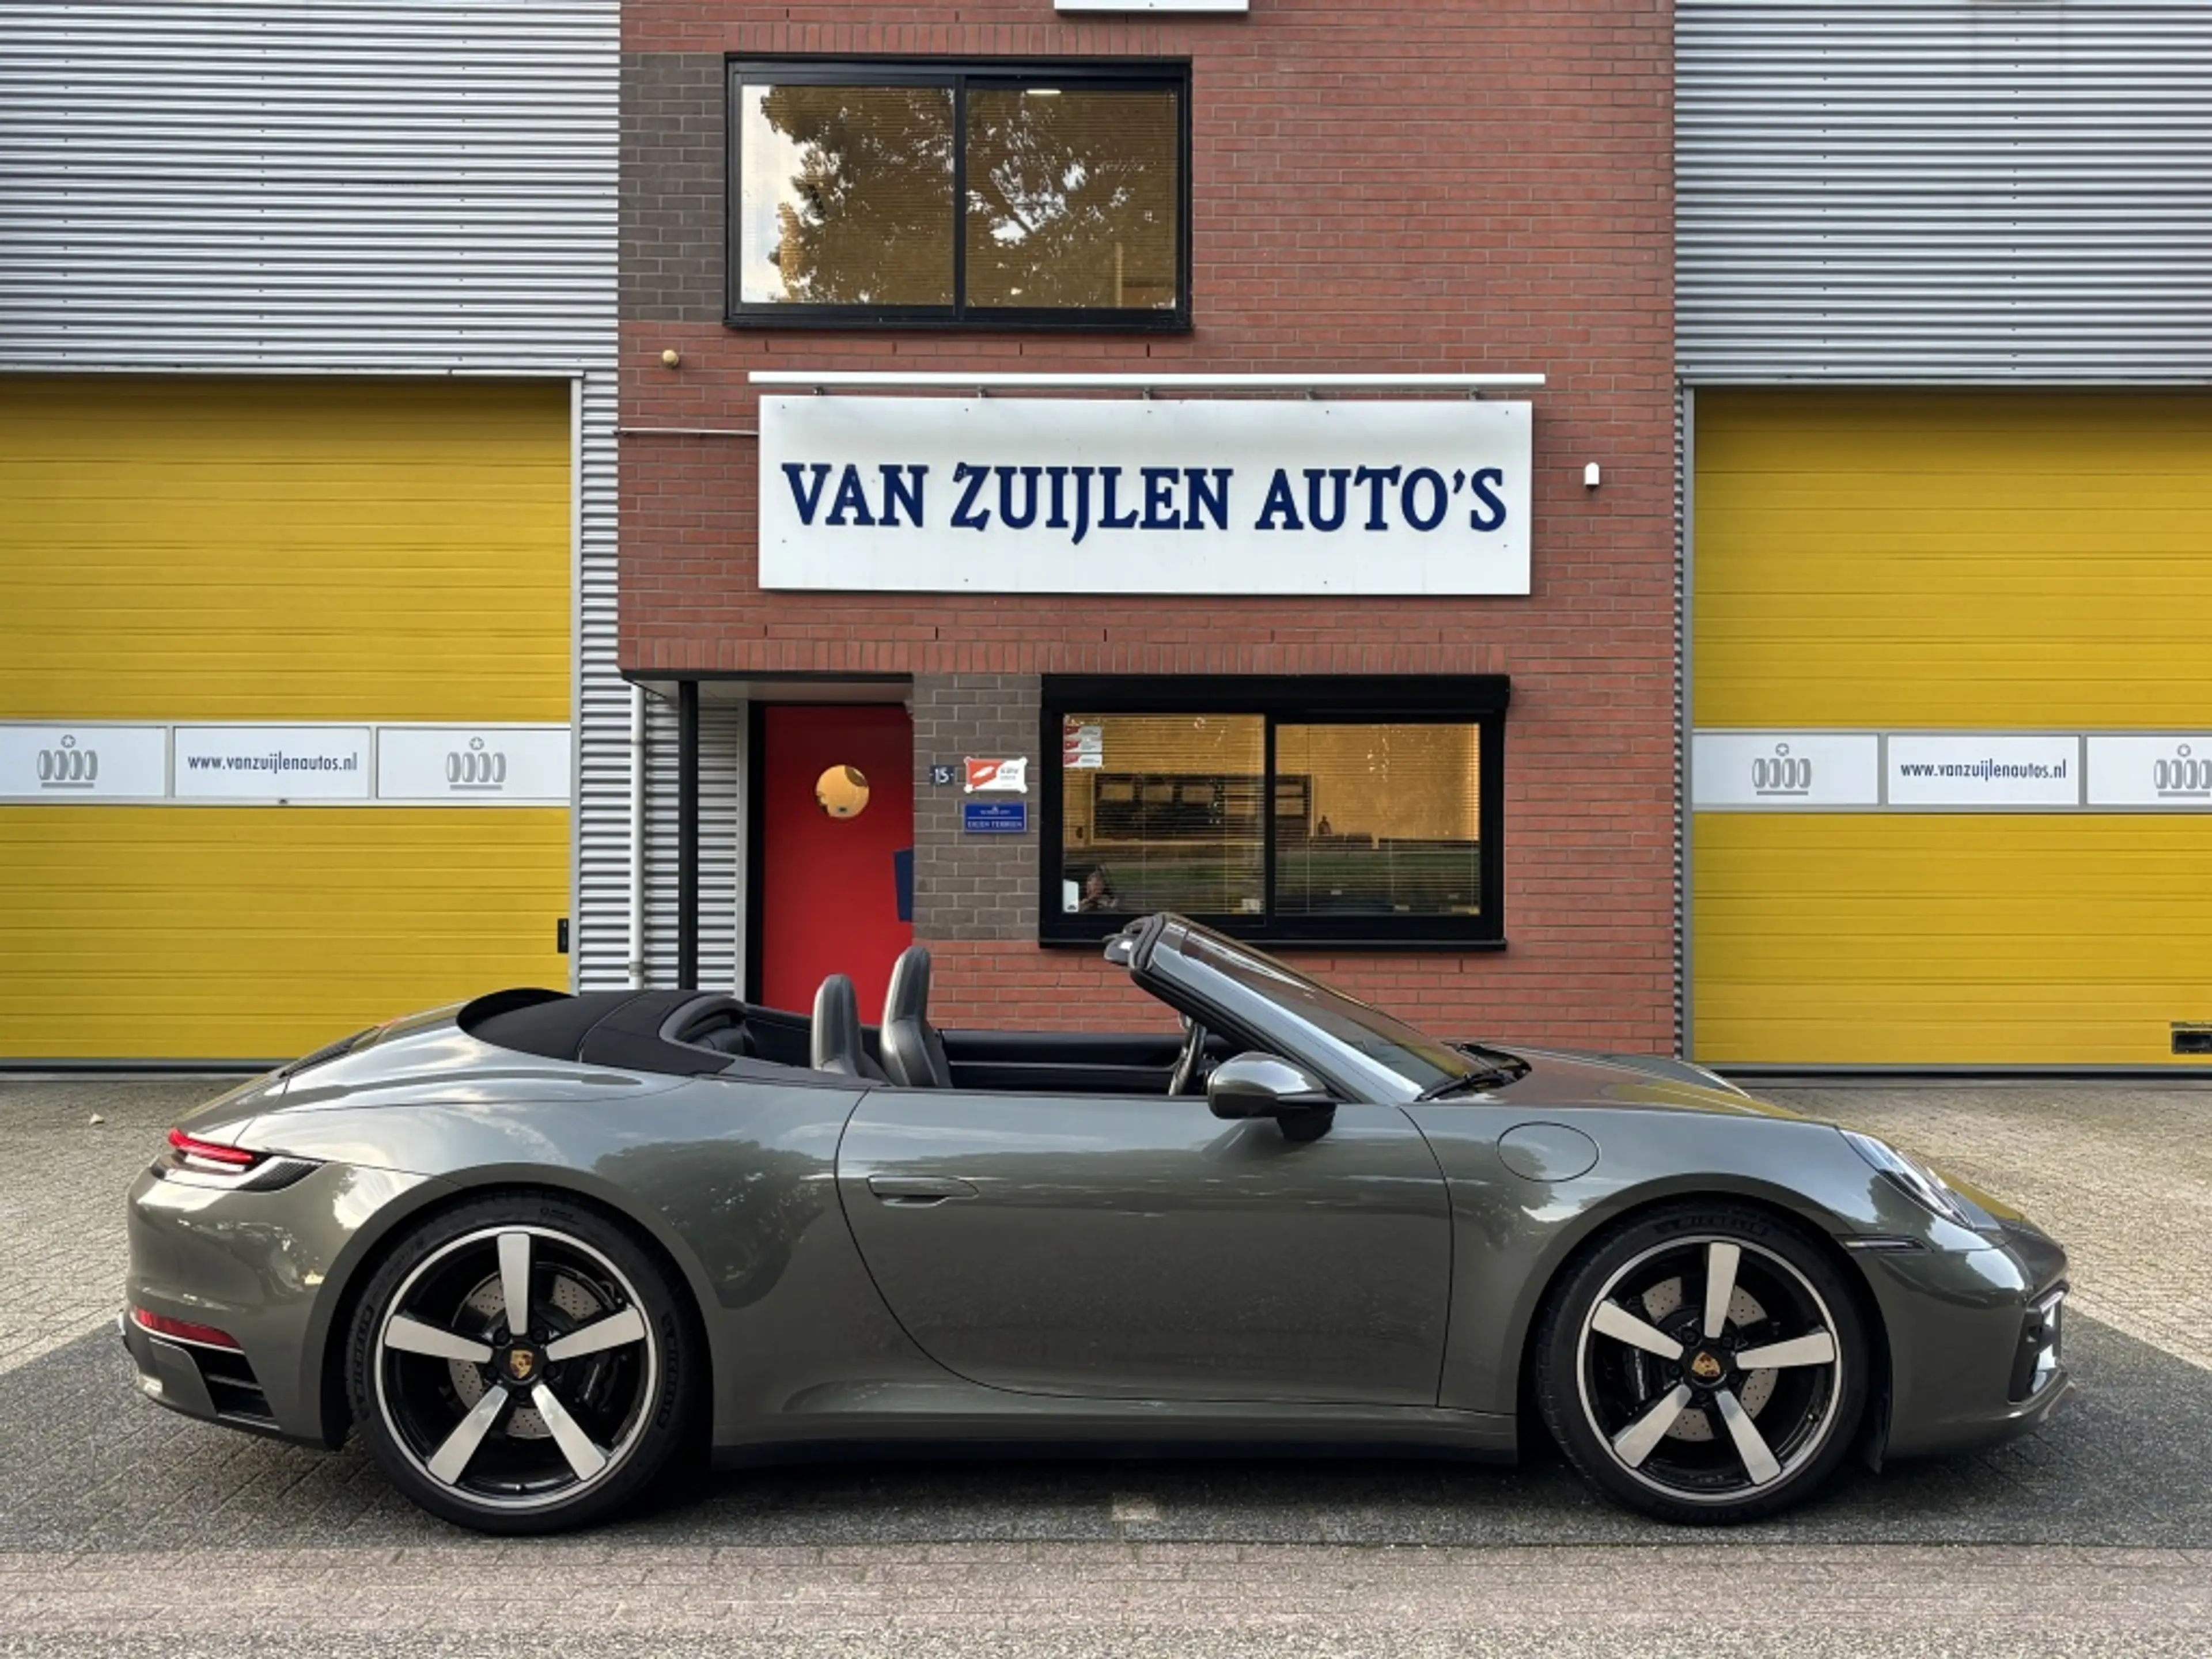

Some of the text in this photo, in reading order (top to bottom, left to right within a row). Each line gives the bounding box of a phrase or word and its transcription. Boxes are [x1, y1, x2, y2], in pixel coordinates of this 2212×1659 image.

[782, 462, 1506, 545] VAN ZUIJLEN AUTO'S
[188, 751, 357, 774] www.vanzuijlenautos.nl
[1900, 758, 2066, 782] www.vanzuijlenautos.nl
[935, 767, 949, 783] 15
